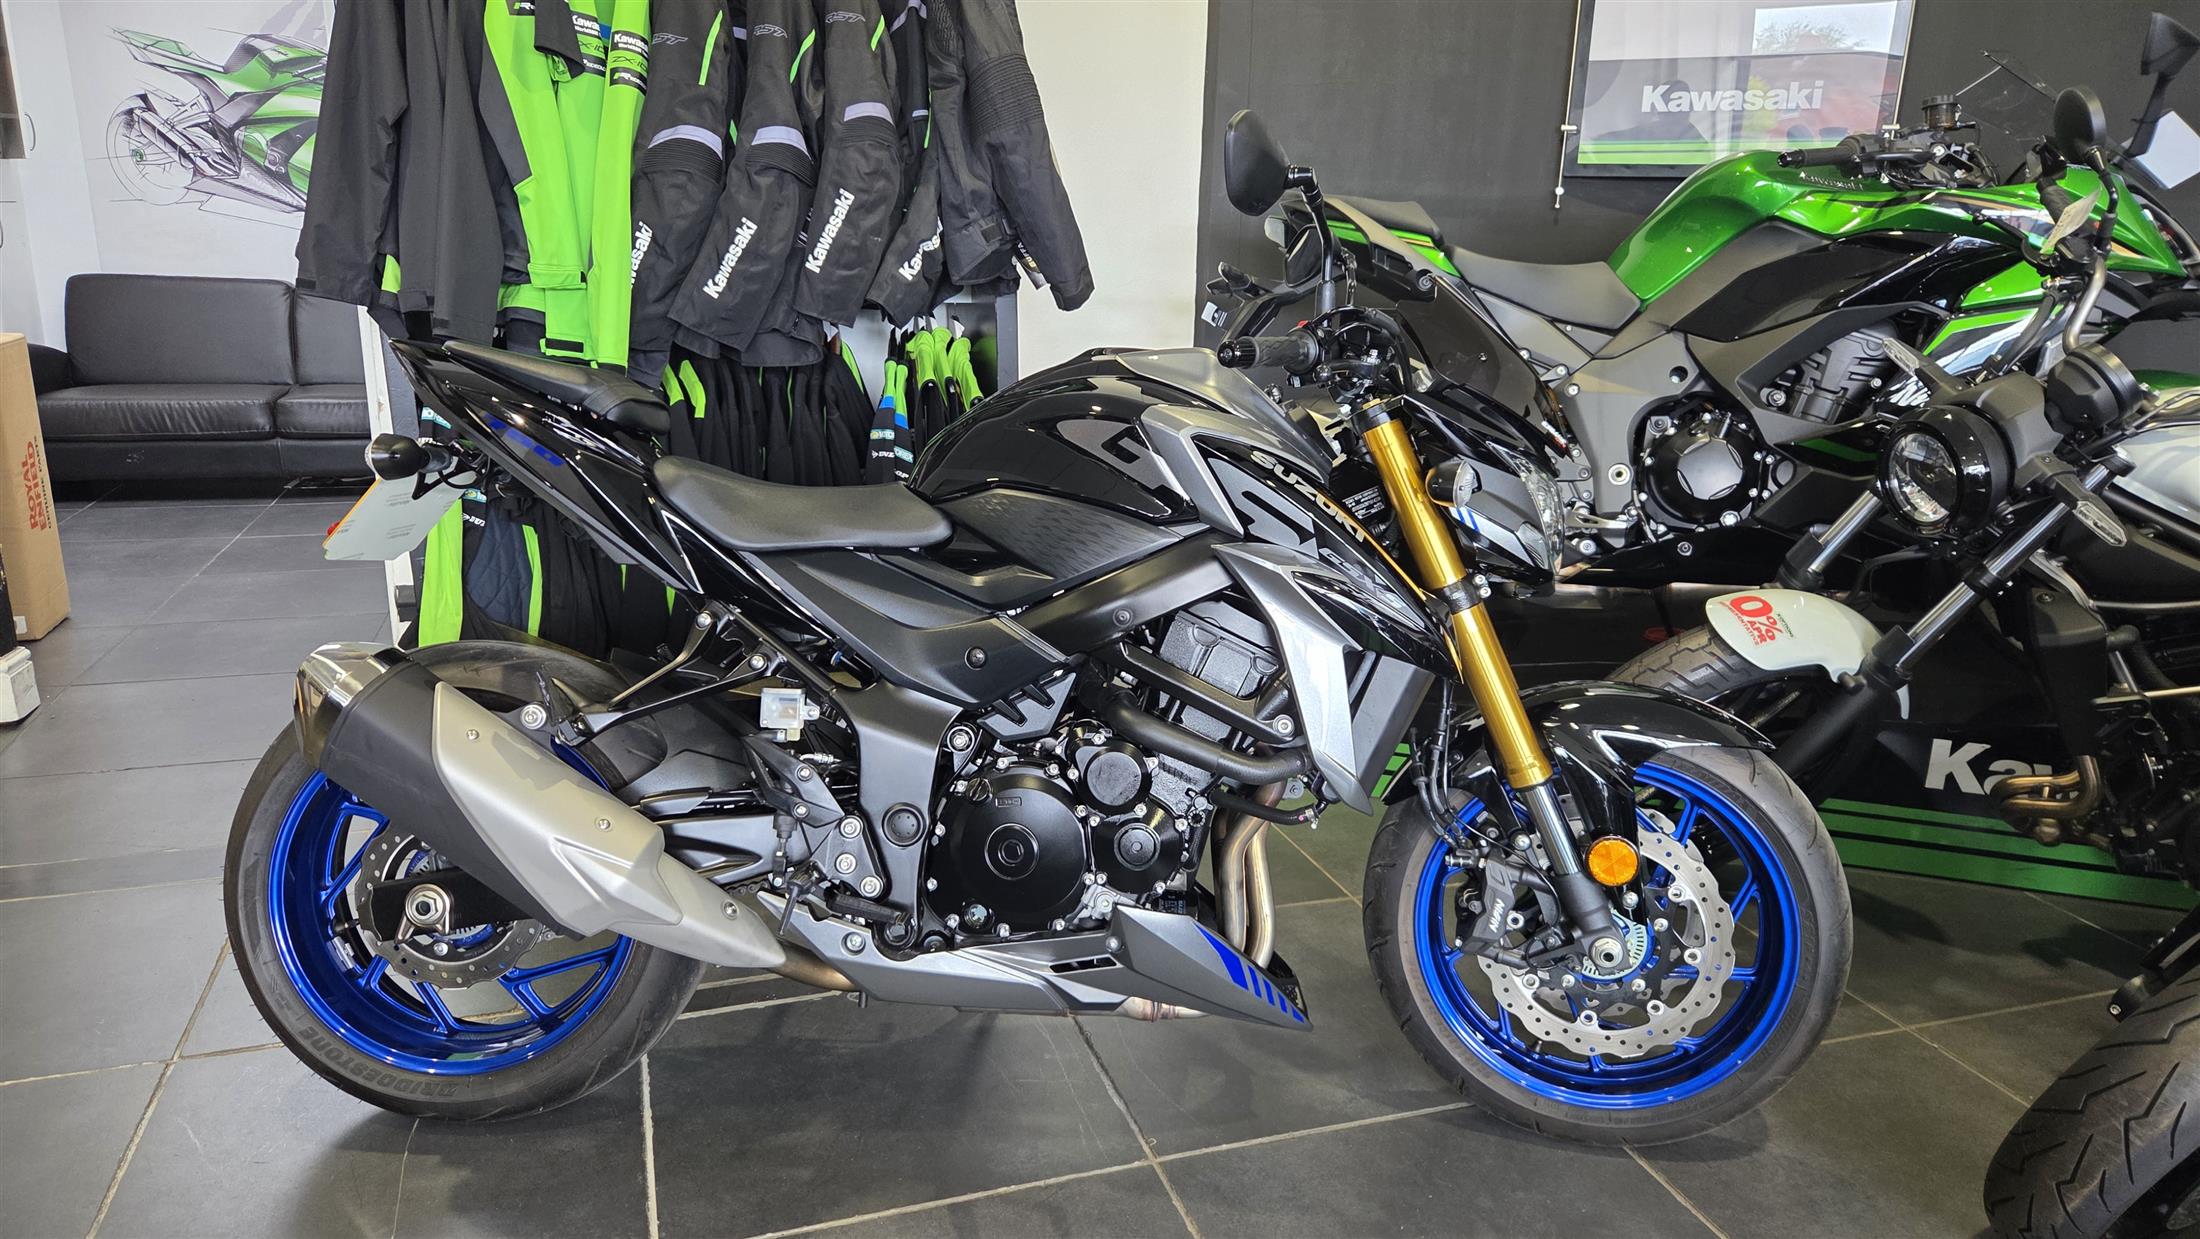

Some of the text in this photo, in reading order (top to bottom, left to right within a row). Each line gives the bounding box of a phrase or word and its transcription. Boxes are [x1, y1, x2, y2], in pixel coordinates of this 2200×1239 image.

[1641, 80, 1824, 113] Kawasaki
[703, 217, 758, 299] Kawasaki
[805, 188, 855, 274] Kawasaki
[22, 454, 39, 530] ROYAL
[27, 441, 47, 531] ENFIELD
[1251, 451, 1365, 543] SUZUKI
[1729, 596, 1783, 641] 0%
[1746, 620, 1768, 644] APR
[300, 1026, 457, 1097] BRIDGESTONE
